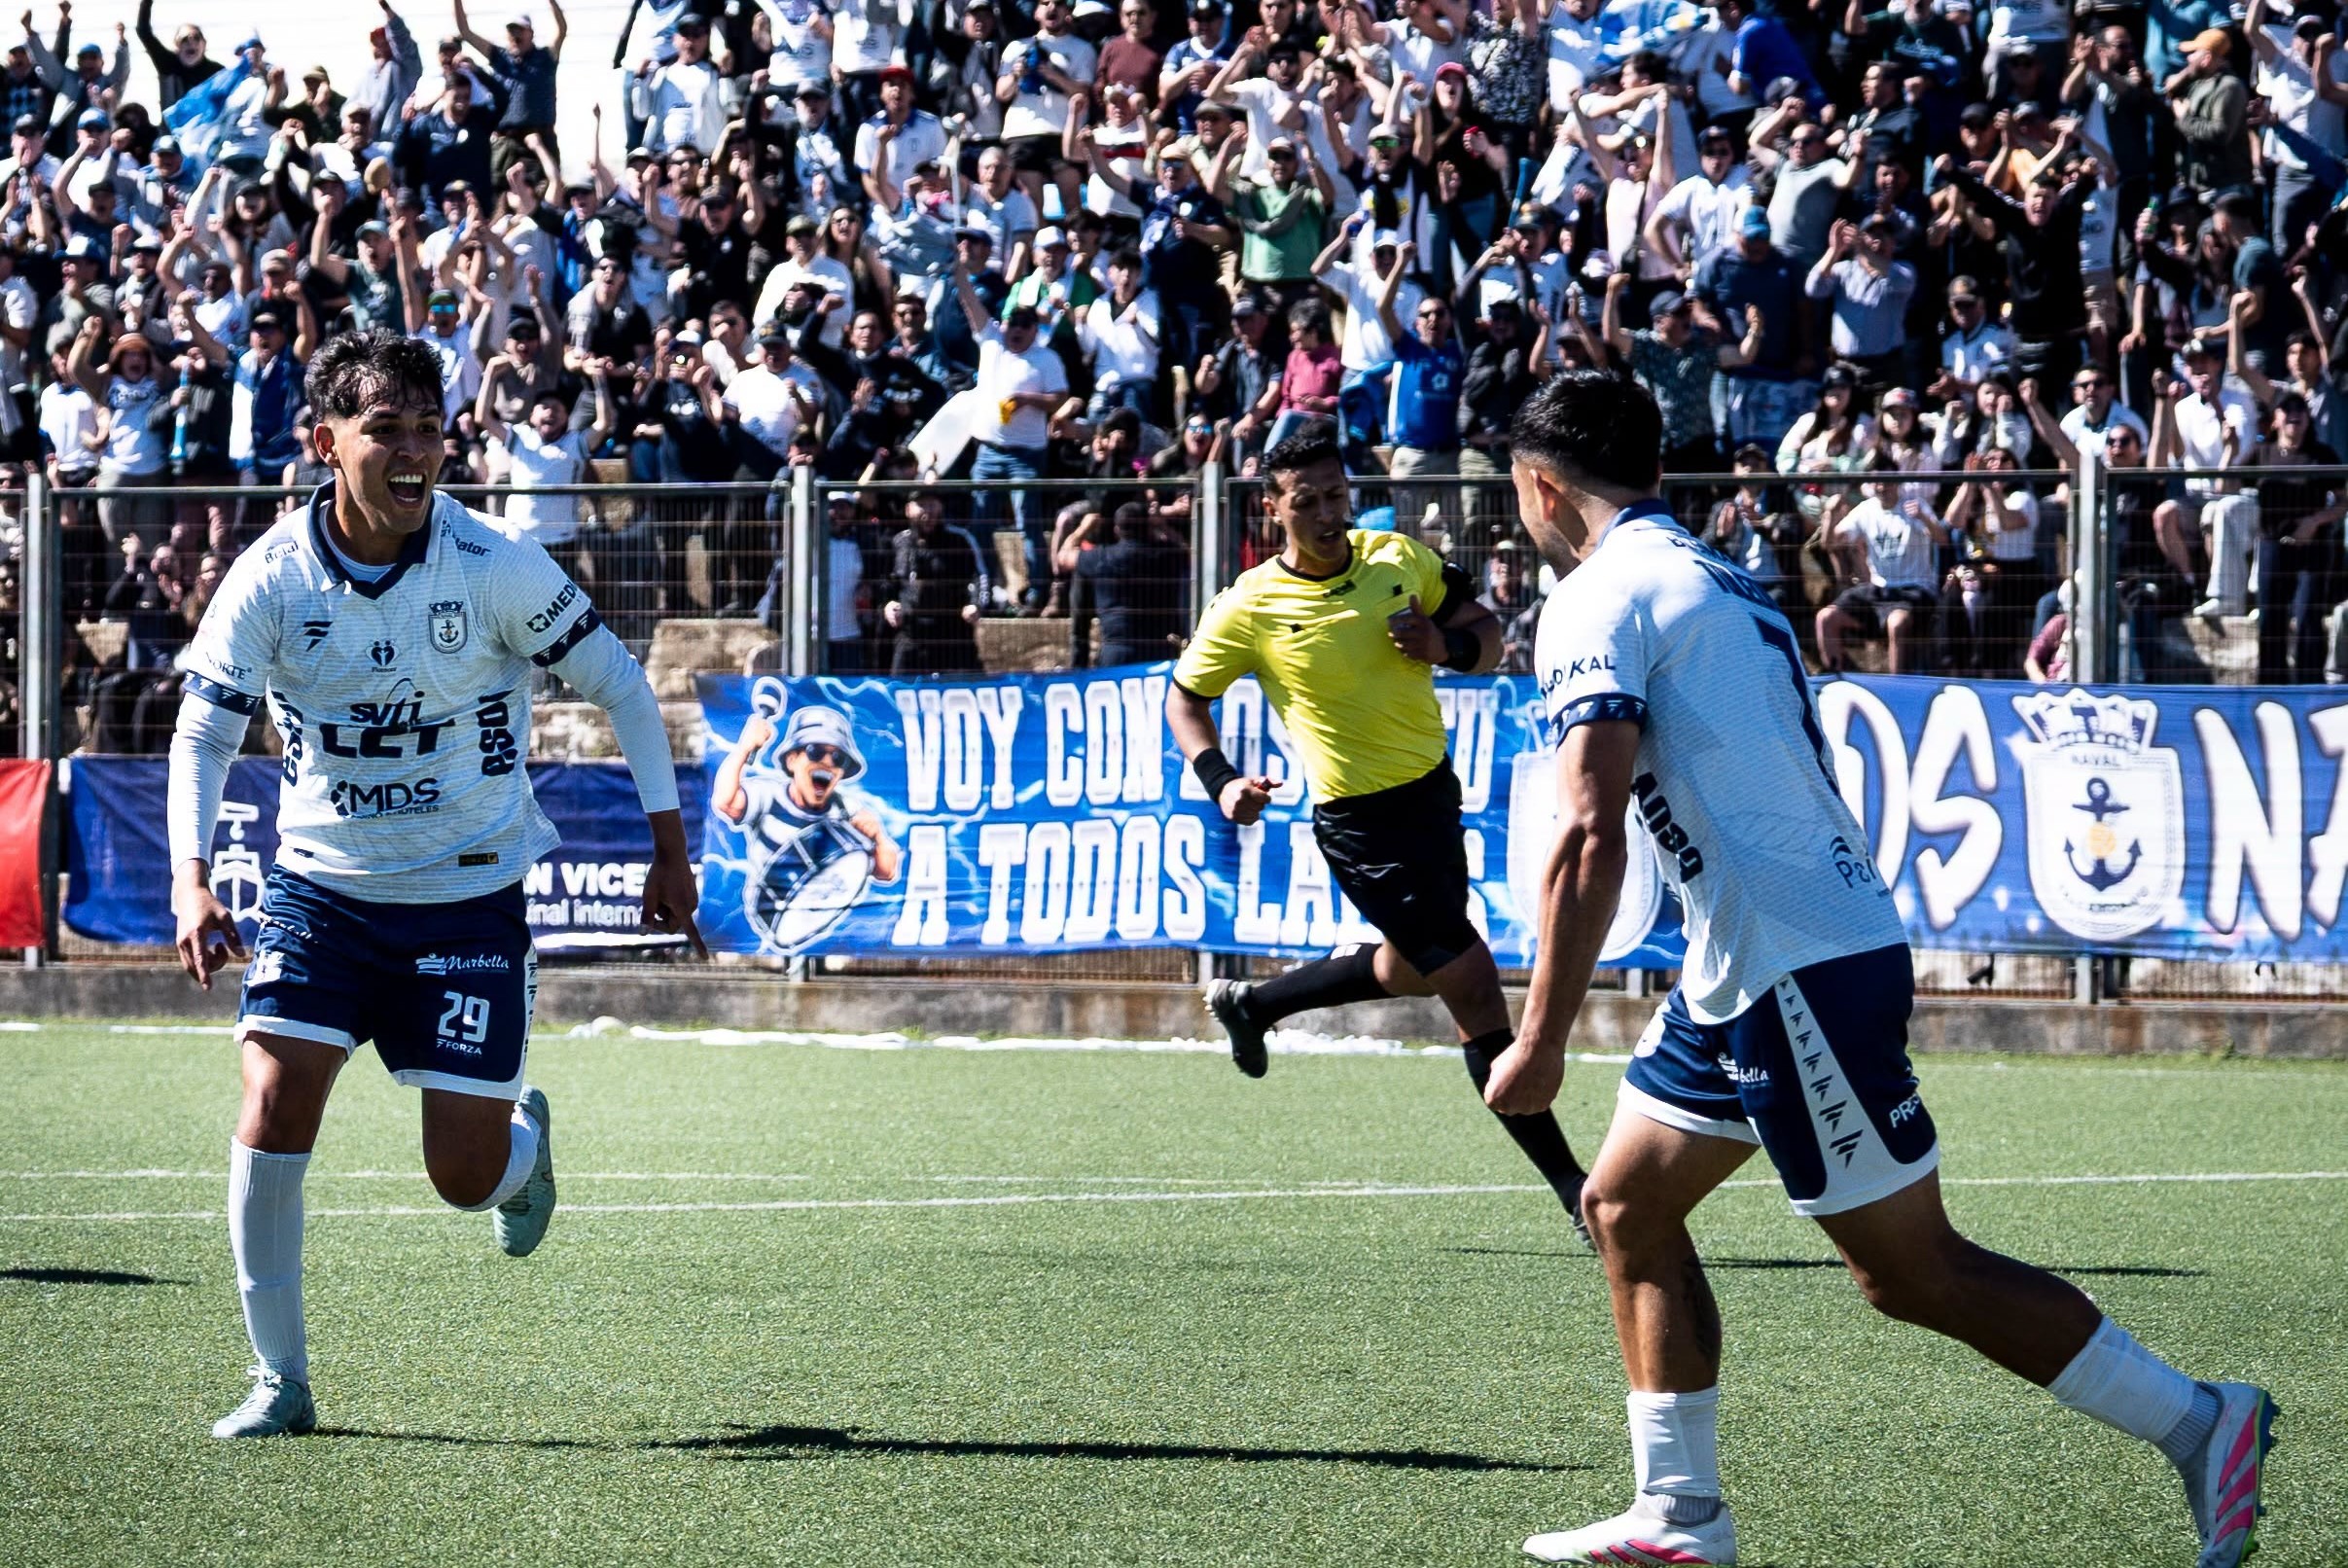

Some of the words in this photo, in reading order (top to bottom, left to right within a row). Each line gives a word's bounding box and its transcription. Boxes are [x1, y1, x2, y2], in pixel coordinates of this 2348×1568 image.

[895, 685, 1024, 811] VOY
[1044, 675, 1166, 806] CON
[349, 777, 441, 813] MDS
[891, 825, 949, 945] A
[978, 814, 1206, 945] TODOS
[438, 990, 490, 1043] 29
[445, 1042, 482, 1055] FORZA
